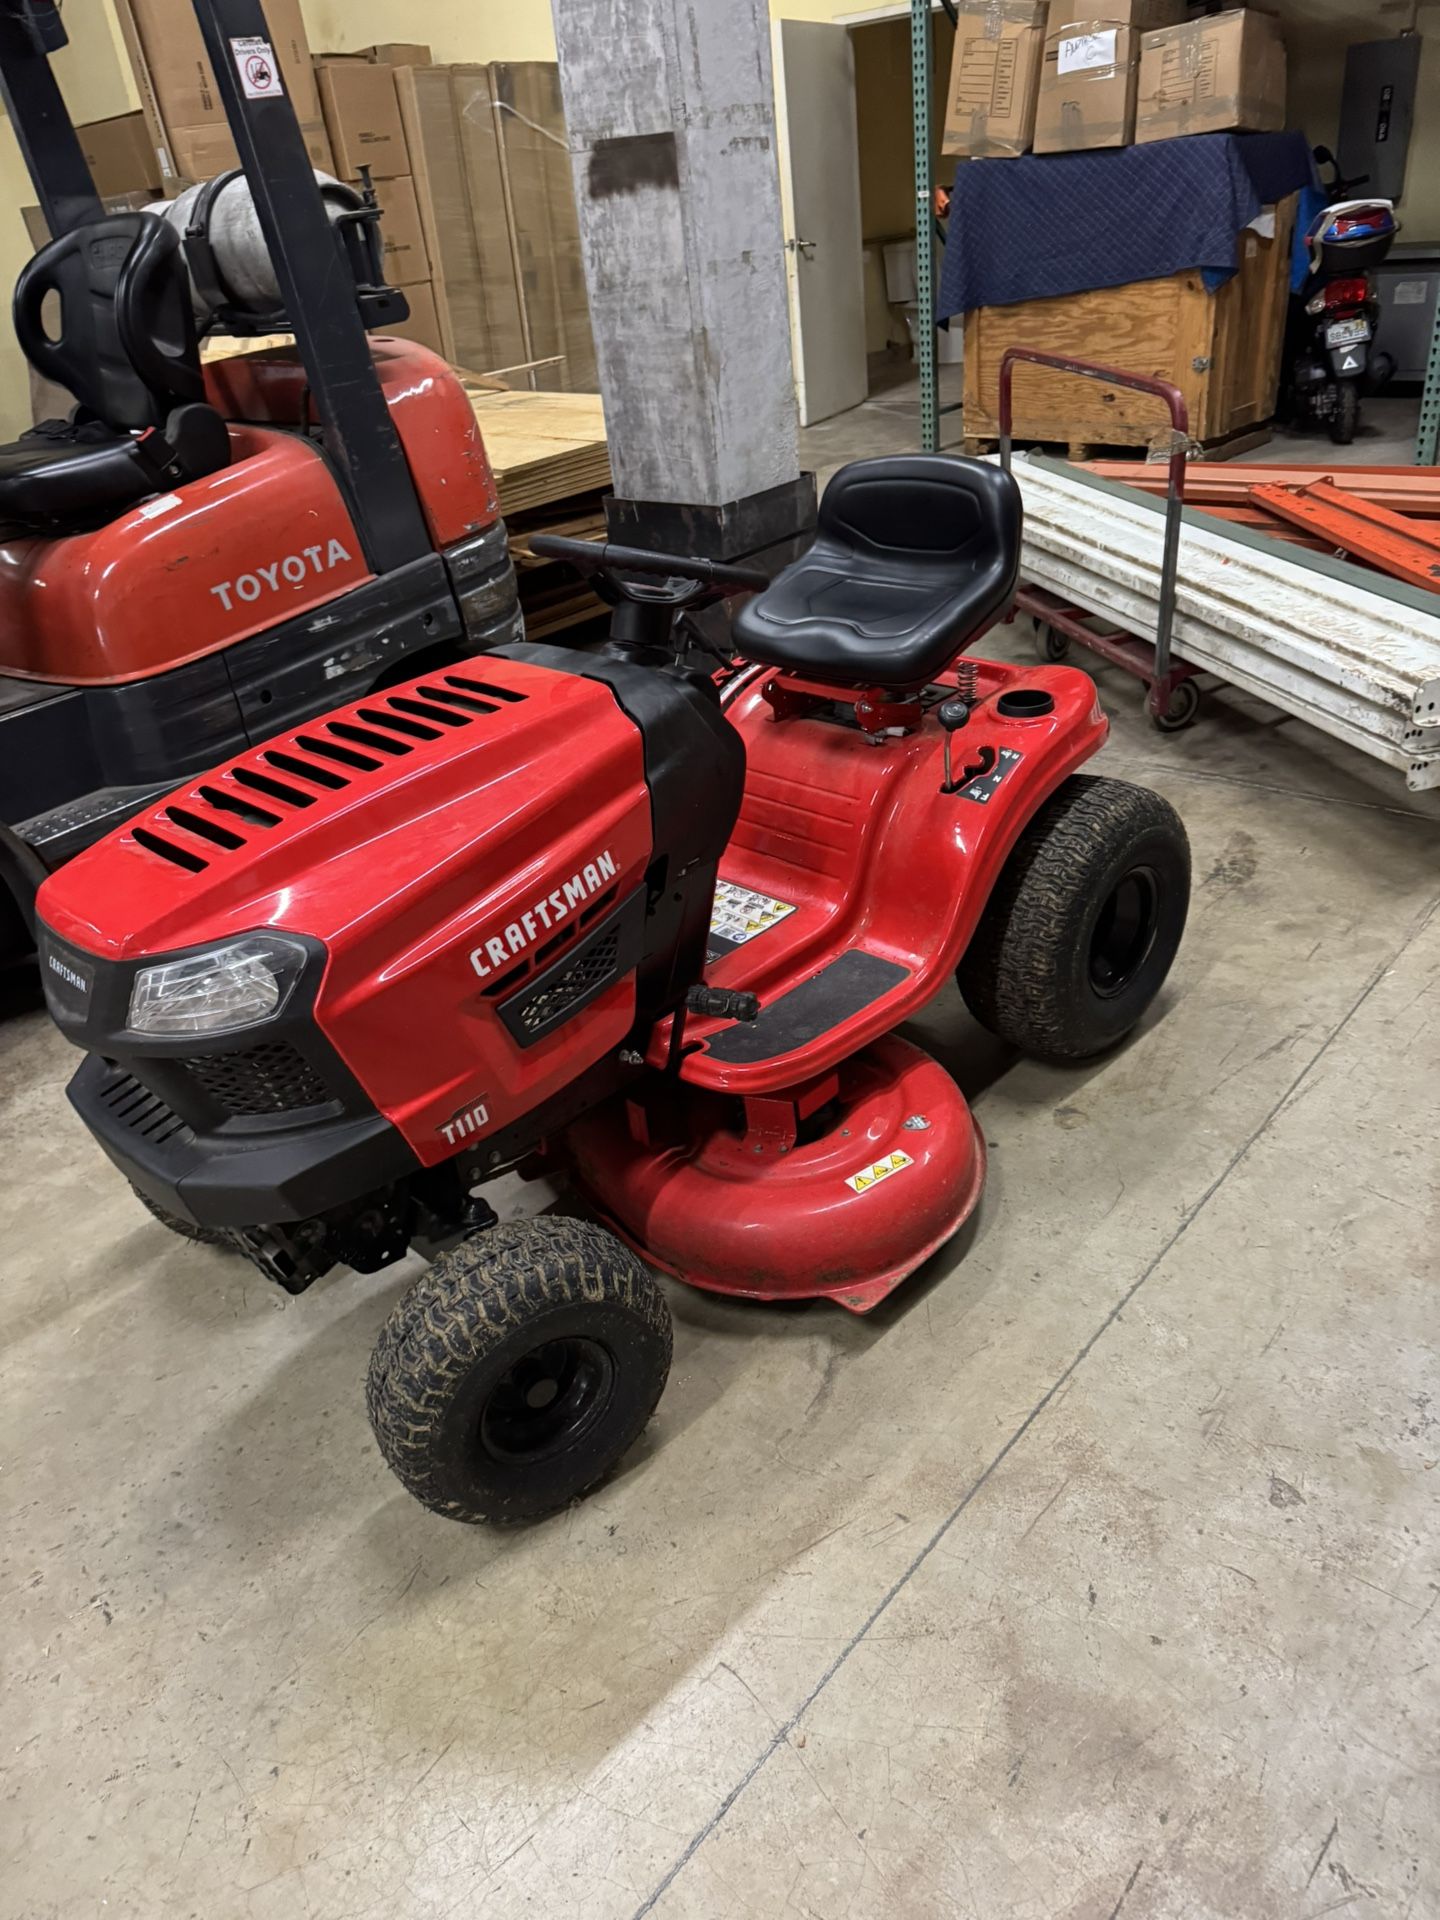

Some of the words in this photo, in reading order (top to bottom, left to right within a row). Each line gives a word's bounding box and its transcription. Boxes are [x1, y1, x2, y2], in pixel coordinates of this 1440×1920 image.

[235, 48, 256, 56] Drivers
[256, 46, 271, 54] Only
[210, 538, 352, 611] TOYOTA
[980, 793, 989, 801] F
[470, 850, 617, 977] CRAFTSMAN
[48, 955, 86, 993] CRAFTSMAN
[441, 1104, 489, 1145] T110
